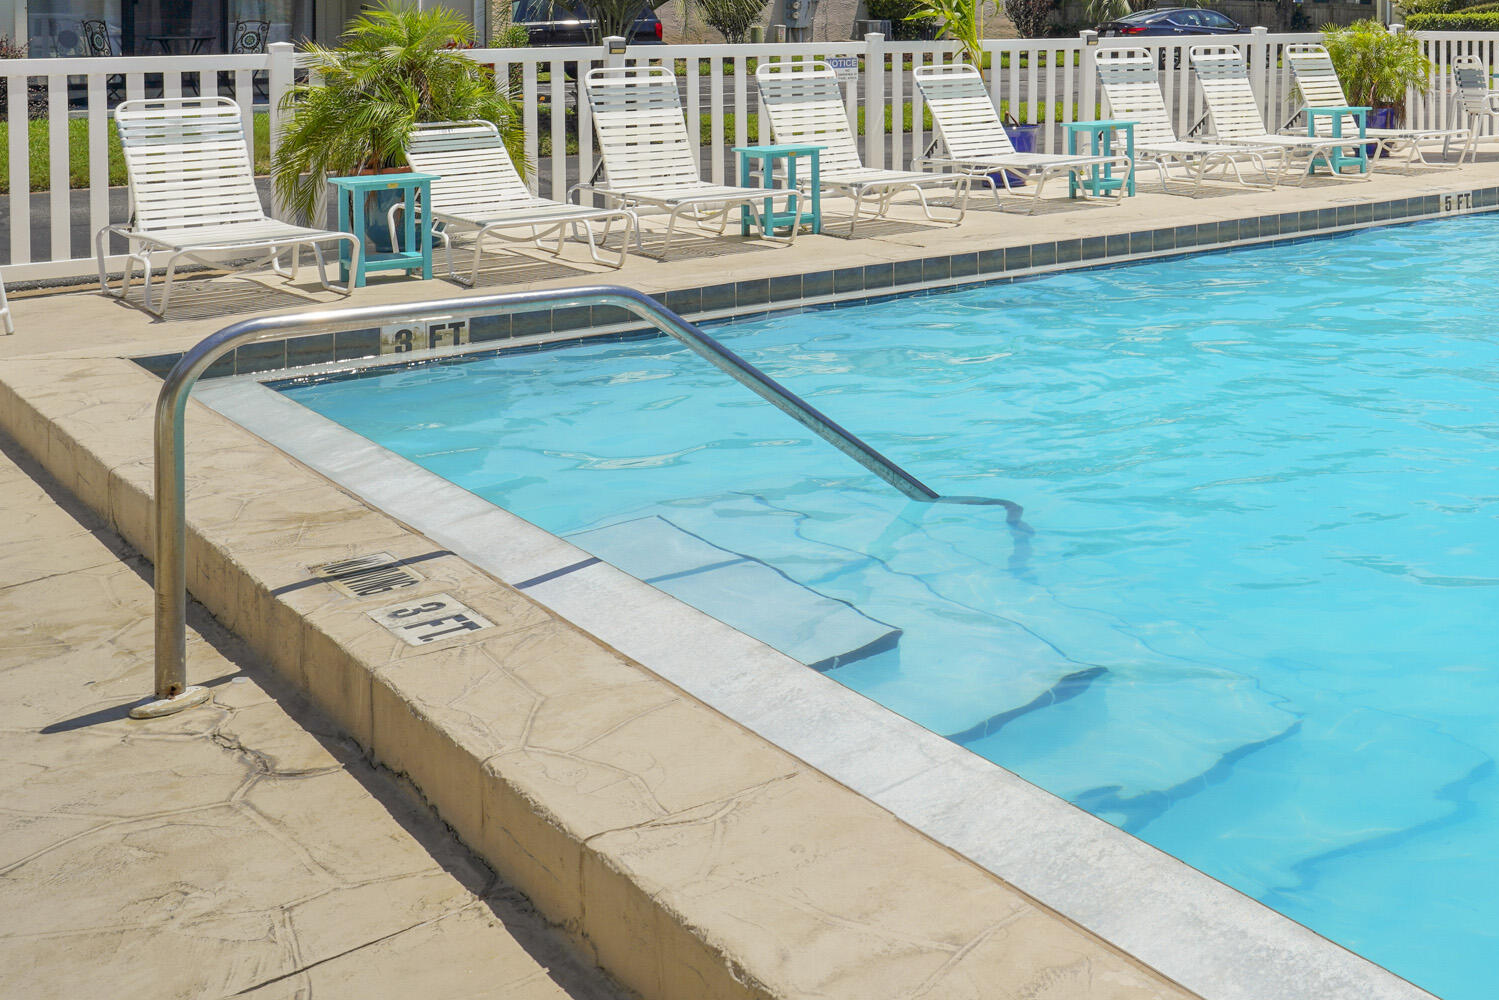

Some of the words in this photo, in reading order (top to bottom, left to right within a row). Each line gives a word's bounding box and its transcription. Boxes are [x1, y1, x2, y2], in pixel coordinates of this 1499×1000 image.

[1444, 195, 1452, 212] 5
[394, 328, 413, 353] 3
[386, 601, 447, 618] 3
[403, 613, 482, 642] FT.
